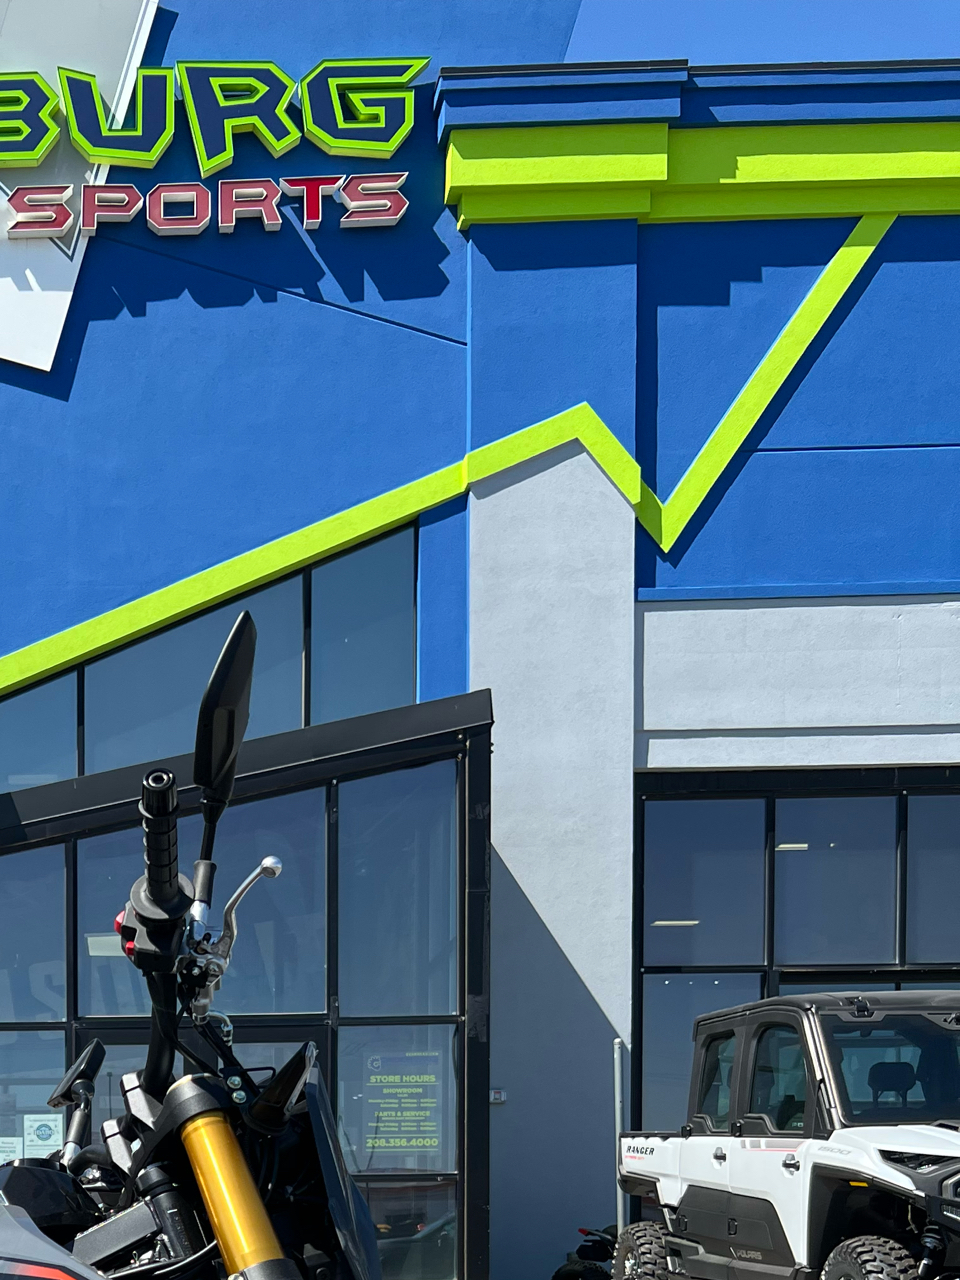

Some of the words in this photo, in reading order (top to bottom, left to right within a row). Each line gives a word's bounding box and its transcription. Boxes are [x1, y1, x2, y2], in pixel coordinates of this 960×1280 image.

[369, 1075, 401, 1083] STORE
[402, 1074, 436, 1082] HOURS
[366, 1138, 438, 1147] 208.356.4000
[626, 1145, 655, 1156] RANGER
[817, 1146, 852, 1155] 1500
[737, 1249, 762, 1260] POLARIS
